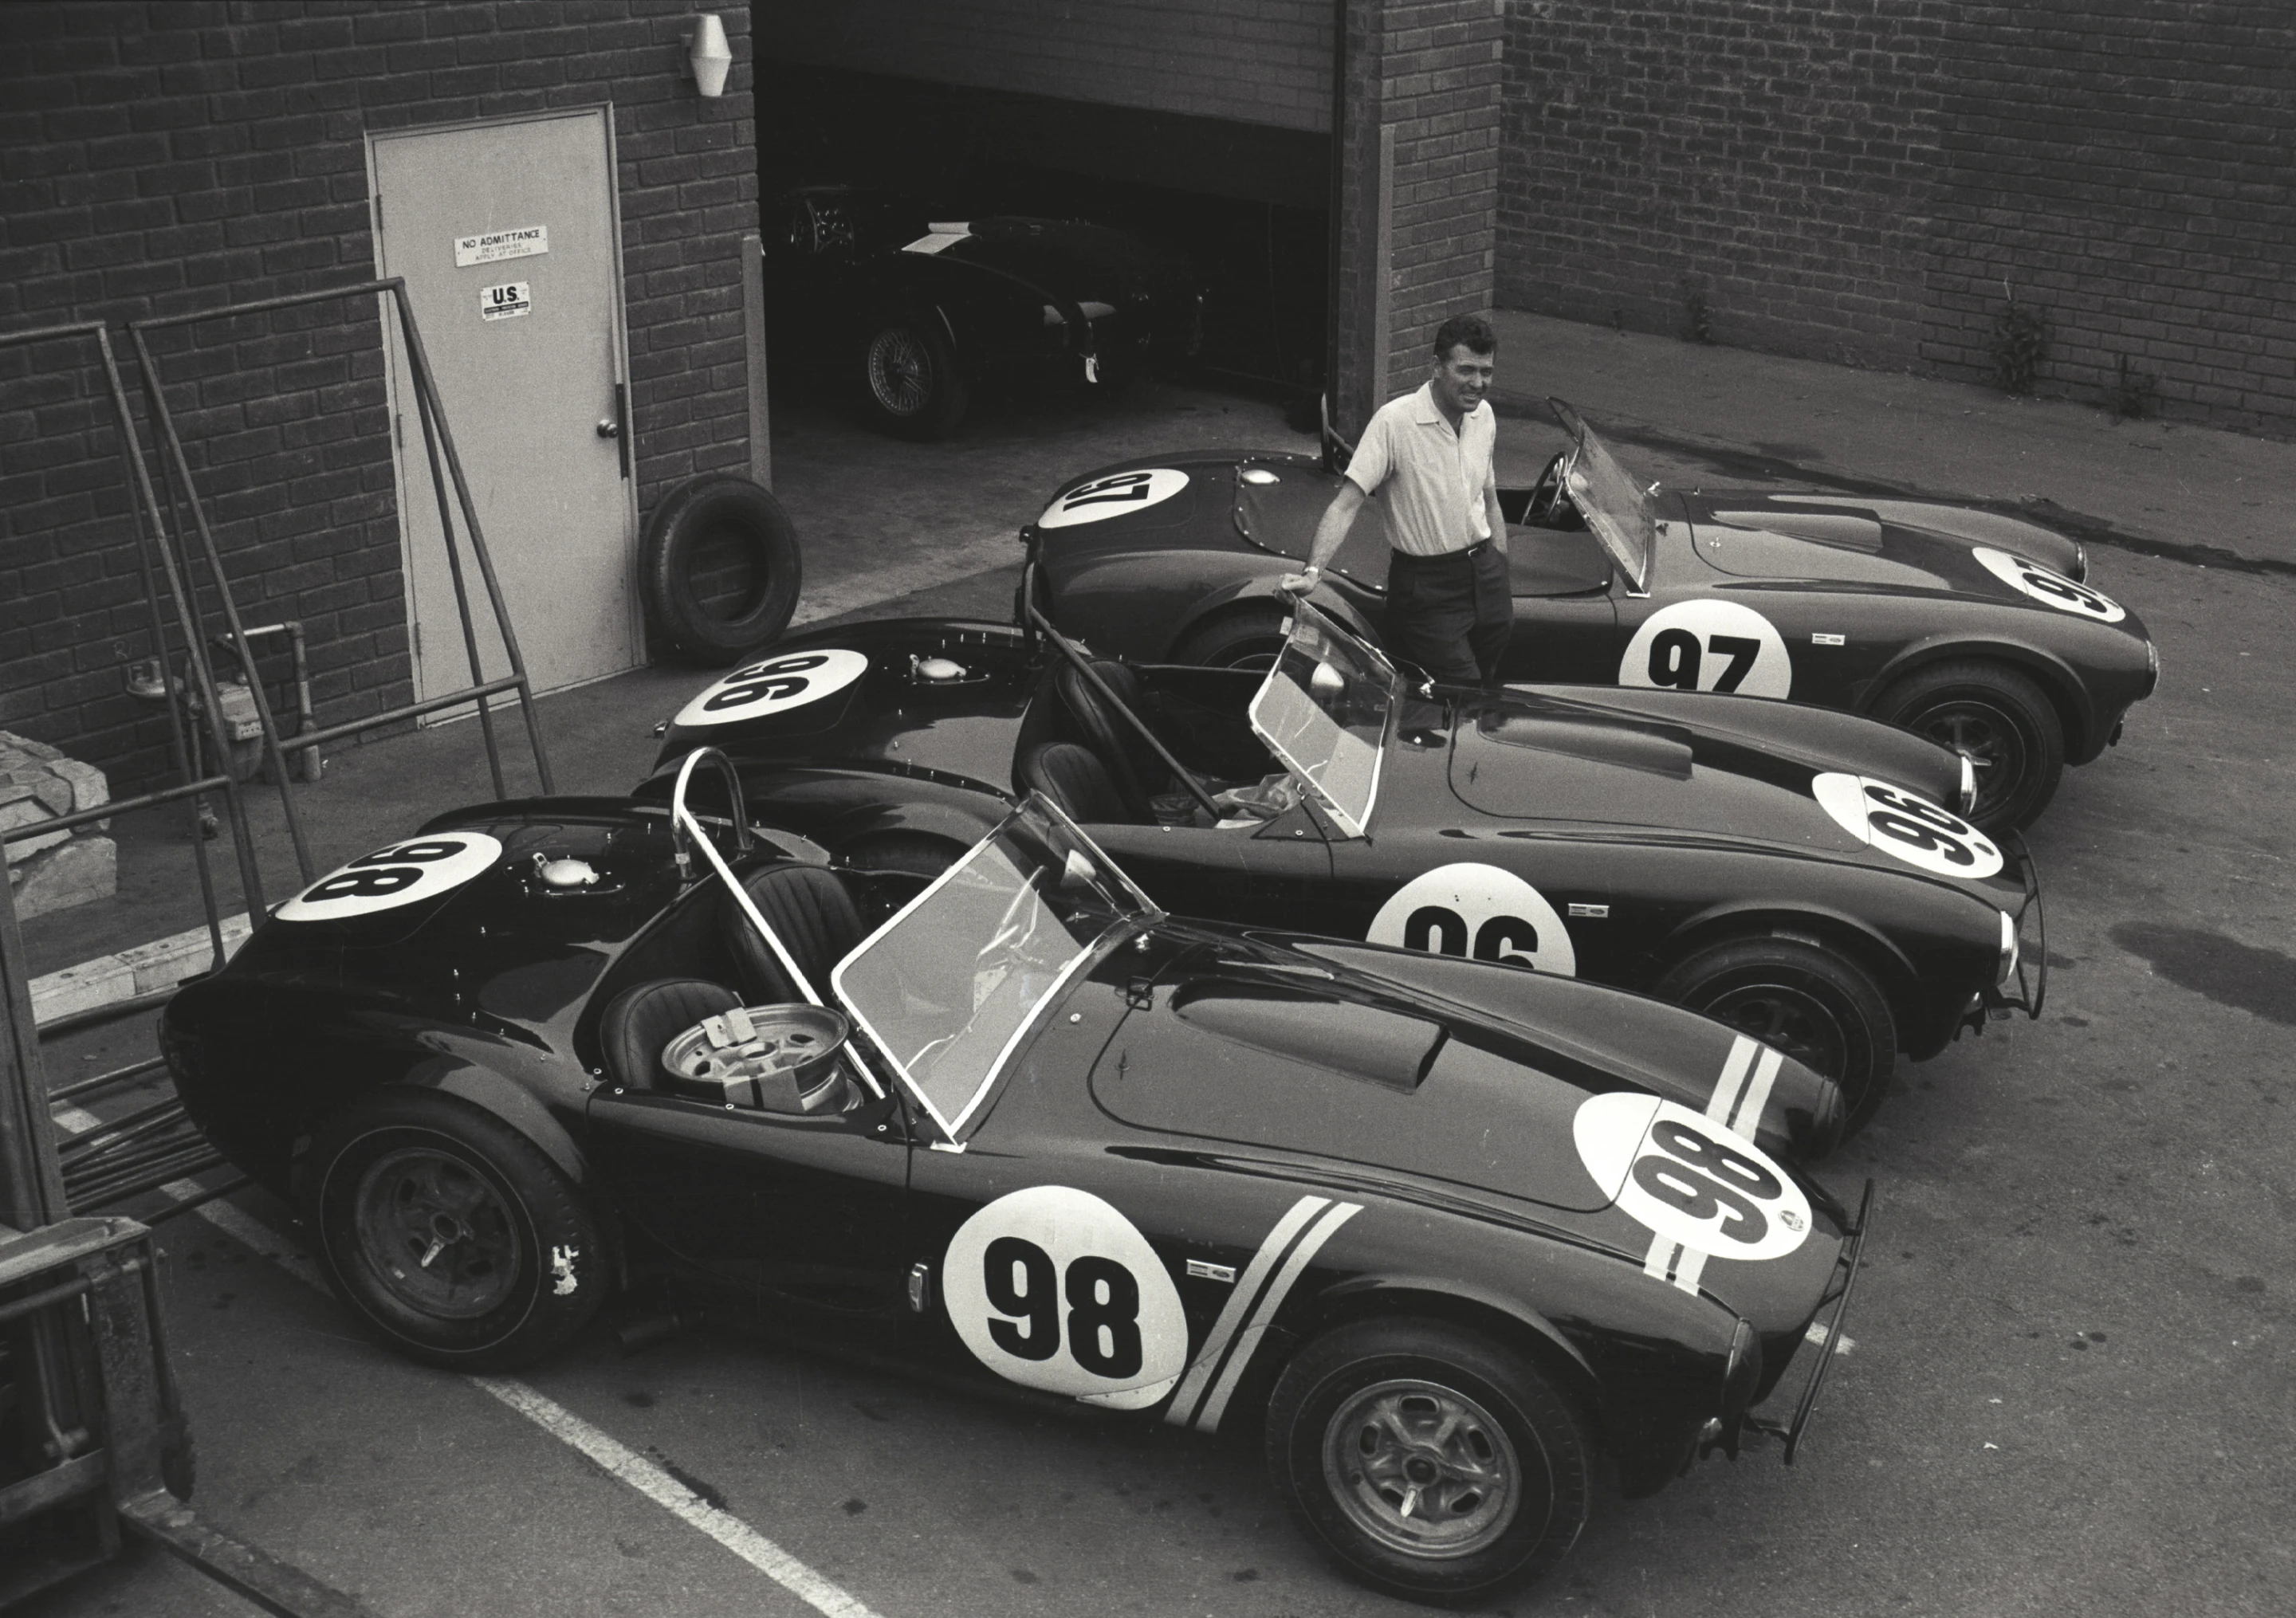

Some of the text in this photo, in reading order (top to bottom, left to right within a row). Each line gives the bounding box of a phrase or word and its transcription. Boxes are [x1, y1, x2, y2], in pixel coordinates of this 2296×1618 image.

[462, 229, 540, 249] NO ADMITTANCE
[482, 242, 521, 253] DELIVERIES
[509, 247, 532, 256] OFFICE
[493, 286, 520, 304] U.S.
[1063, 473, 1153, 512] 97
[703, 655, 829, 712] 96
[1648, 628, 1761, 693] 97
[1863, 785, 1975, 866] 96
[301, 841, 467, 903] 98
[1633, 1120, 1782, 1244] 98
[984, 1236, 1143, 1380] 98
